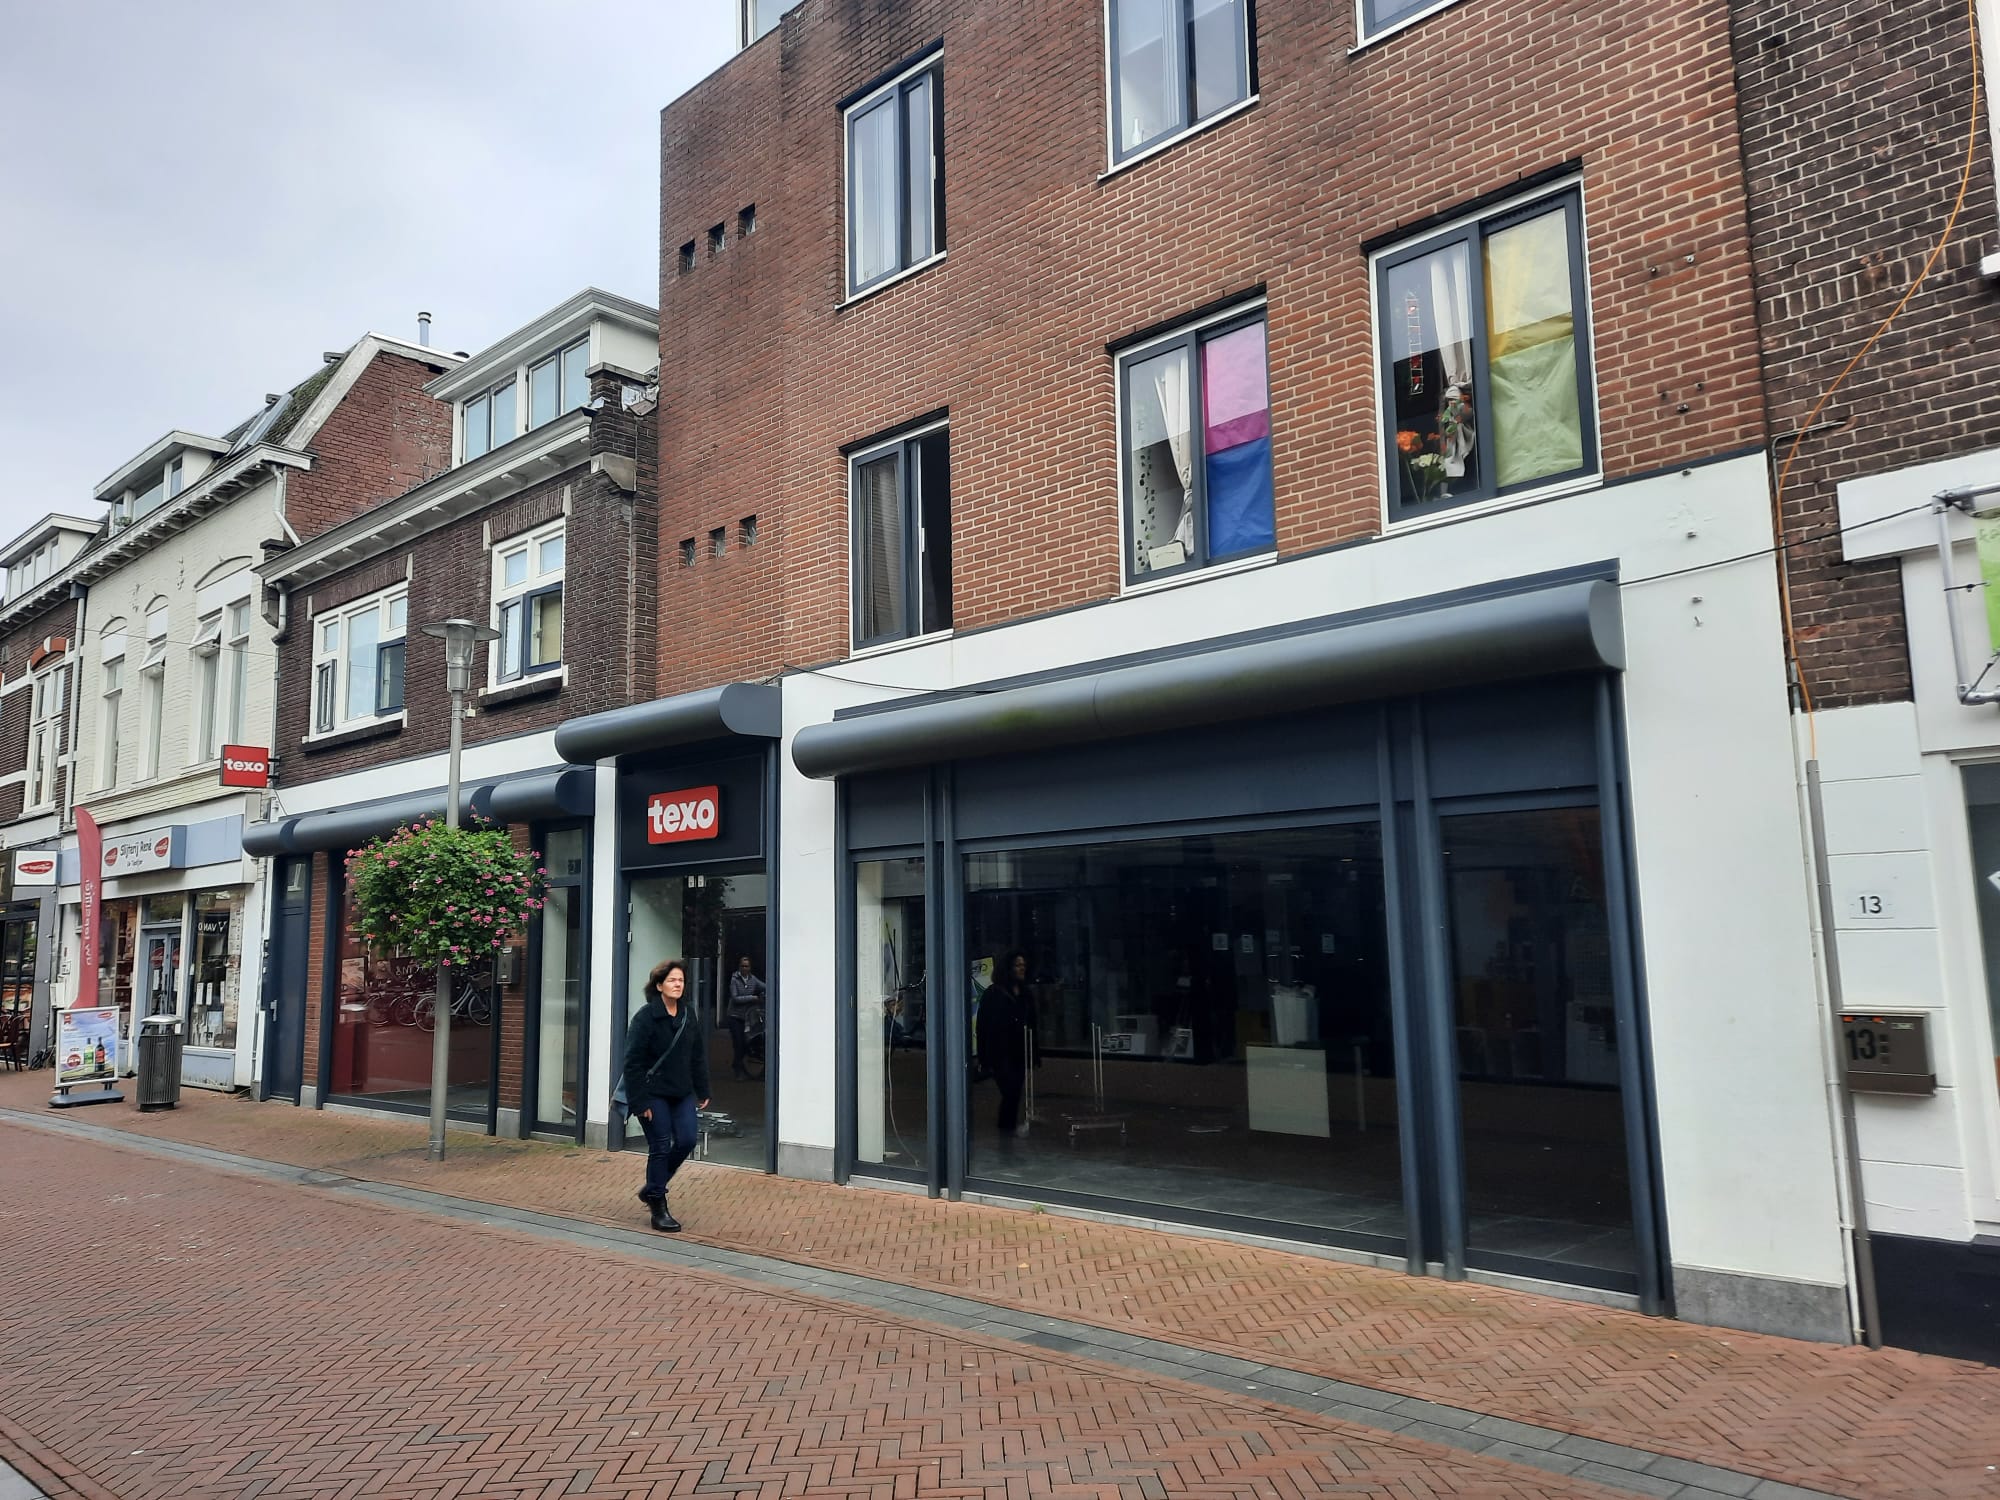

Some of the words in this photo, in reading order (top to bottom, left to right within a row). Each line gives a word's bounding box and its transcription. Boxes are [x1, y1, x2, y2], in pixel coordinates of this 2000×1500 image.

[224, 758, 265, 773] texo
[648, 799, 715, 833] texo
[1859, 896, 1882, 914] 13
[1845, 1029, 1877, 1060] 13
